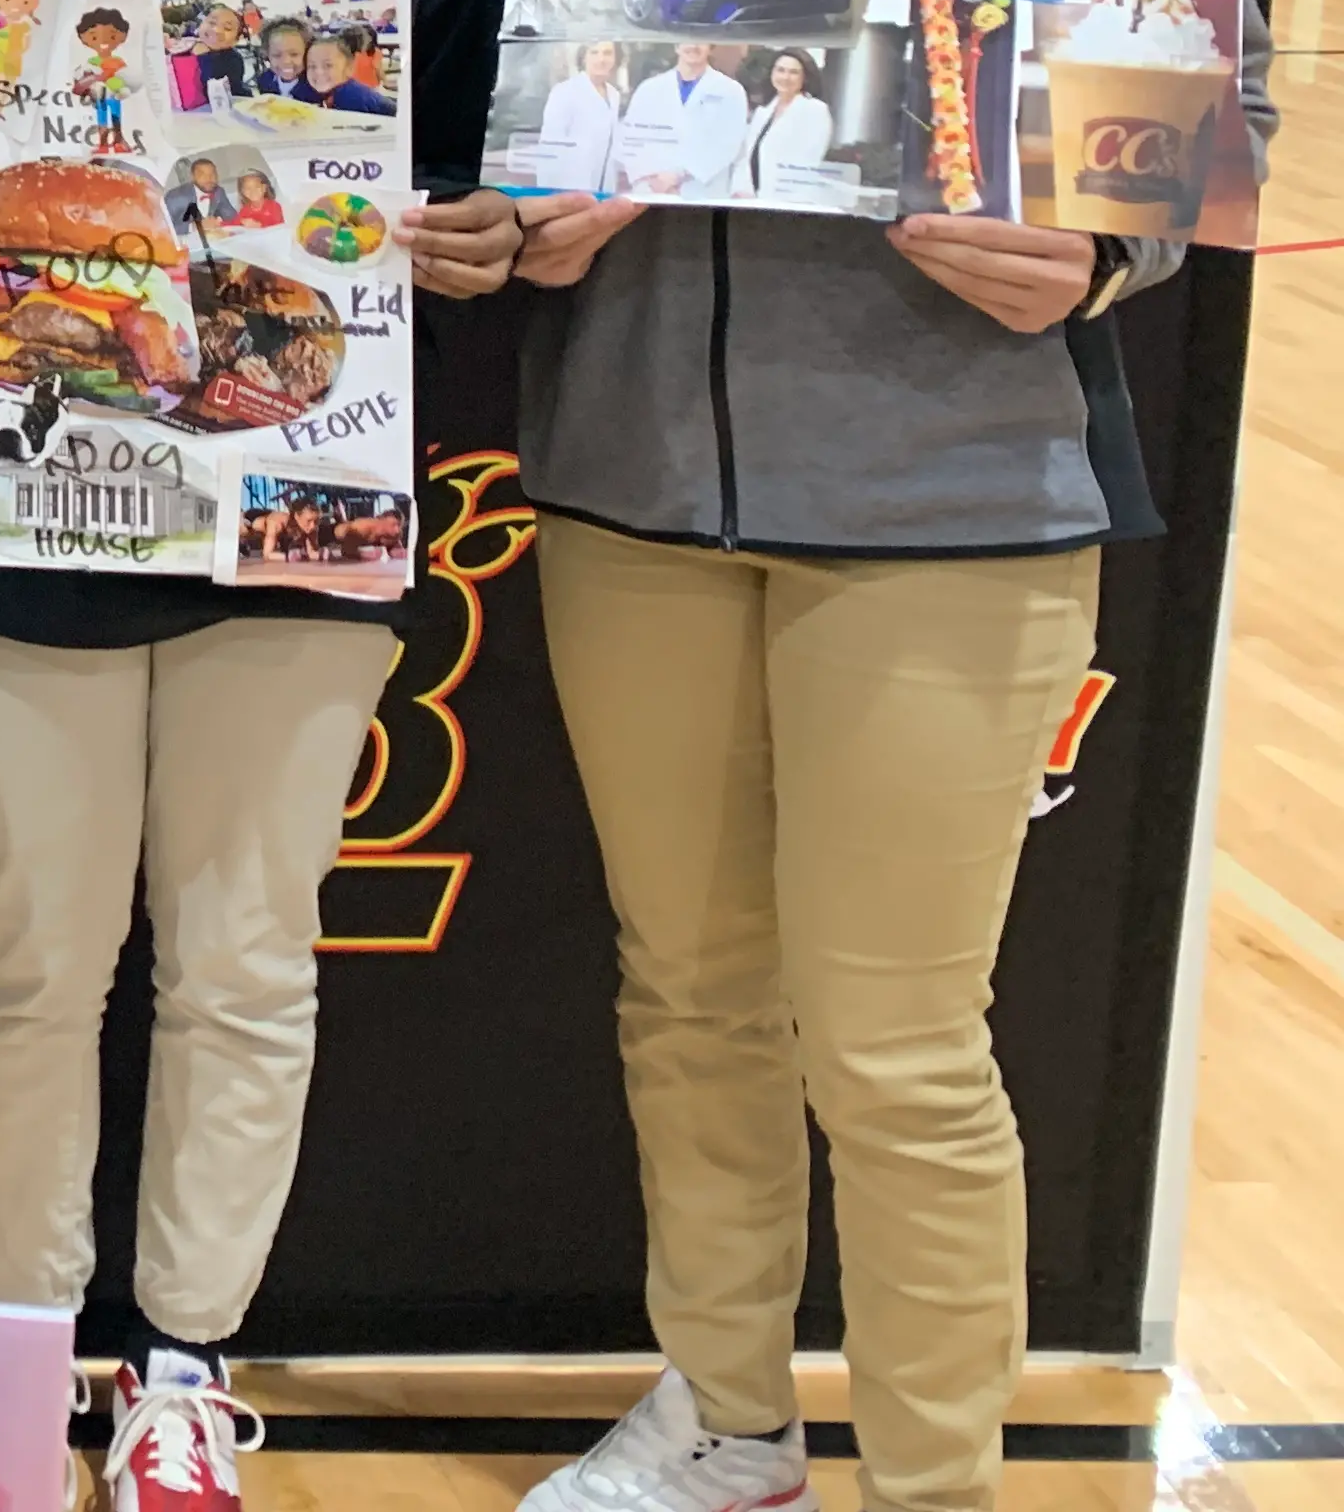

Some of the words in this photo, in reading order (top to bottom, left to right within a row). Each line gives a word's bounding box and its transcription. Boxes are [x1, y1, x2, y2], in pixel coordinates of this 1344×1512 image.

[308, 157, 383, 182] FOOD
[351, 281, 407, 325] Kid
[34, 528, 160, 564] HOUSE
